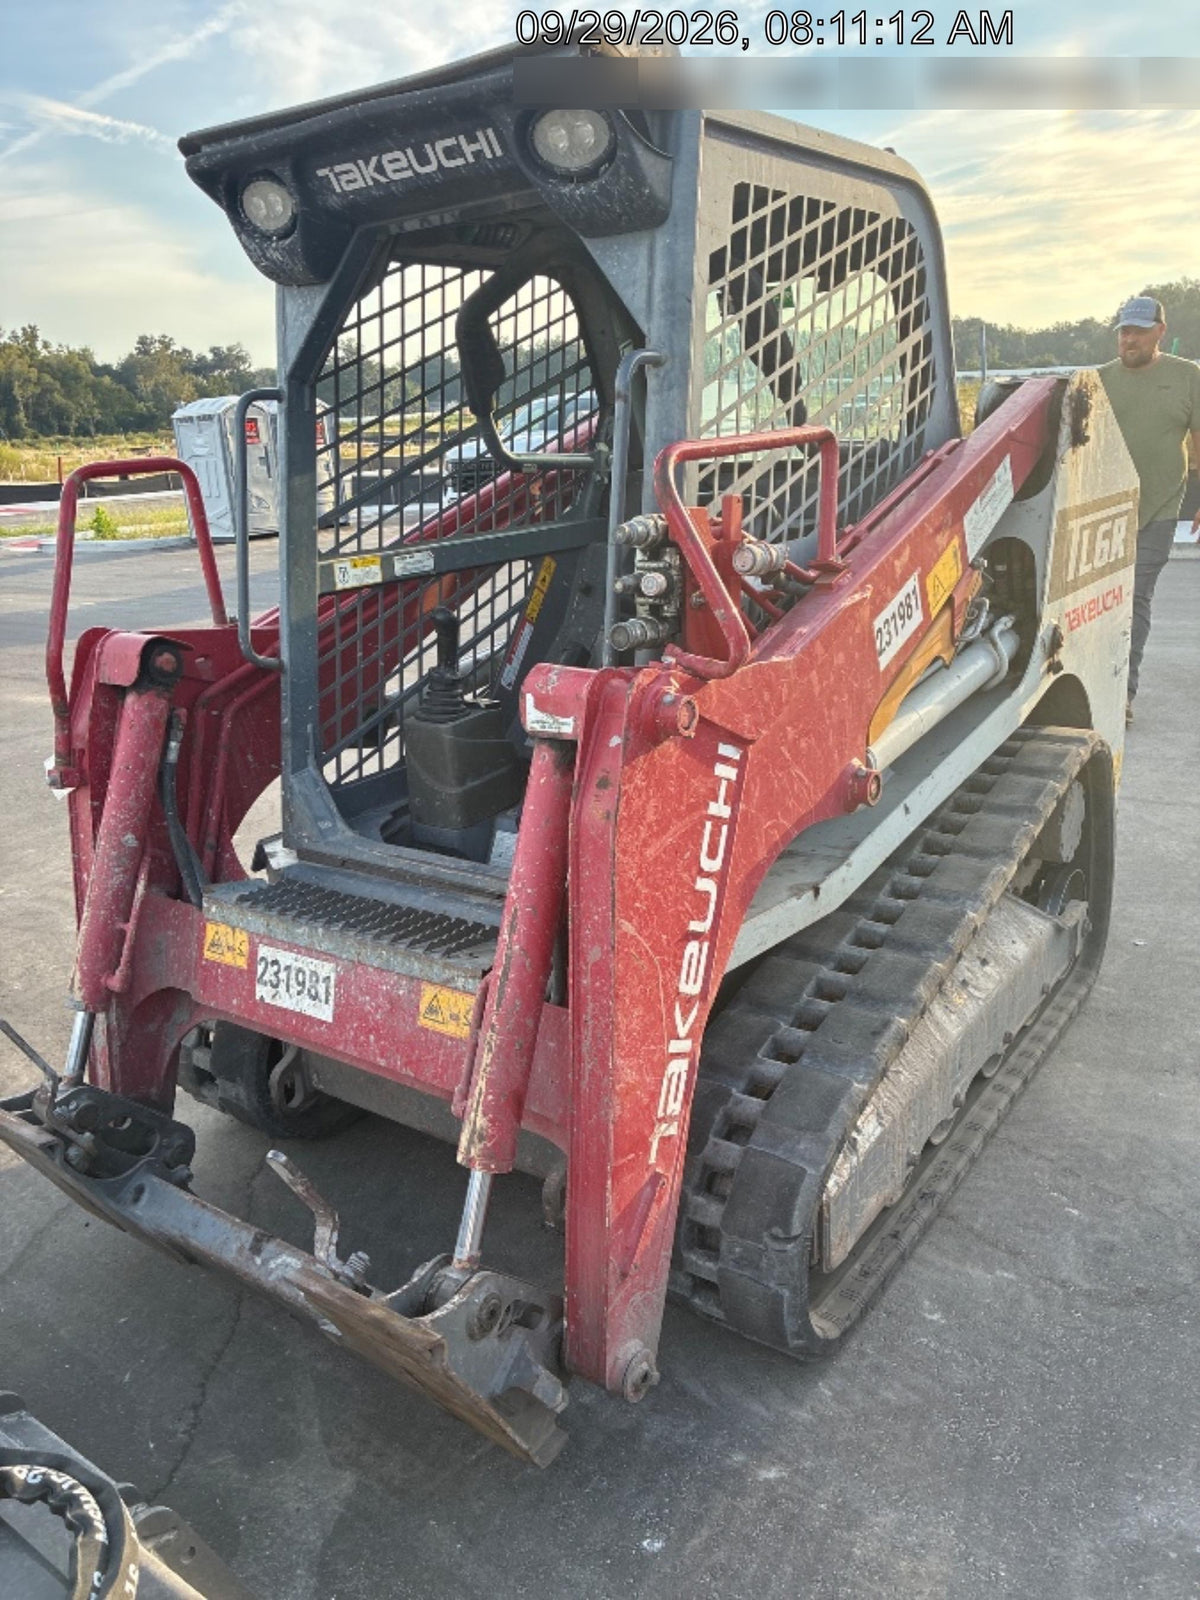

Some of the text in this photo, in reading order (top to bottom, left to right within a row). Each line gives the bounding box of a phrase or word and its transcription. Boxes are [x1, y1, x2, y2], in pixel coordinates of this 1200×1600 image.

[1066, 501, 1134, 583] TL6R
[875, 584, 919, 657] 231981
[257, 956, 332, 1005] 231981
